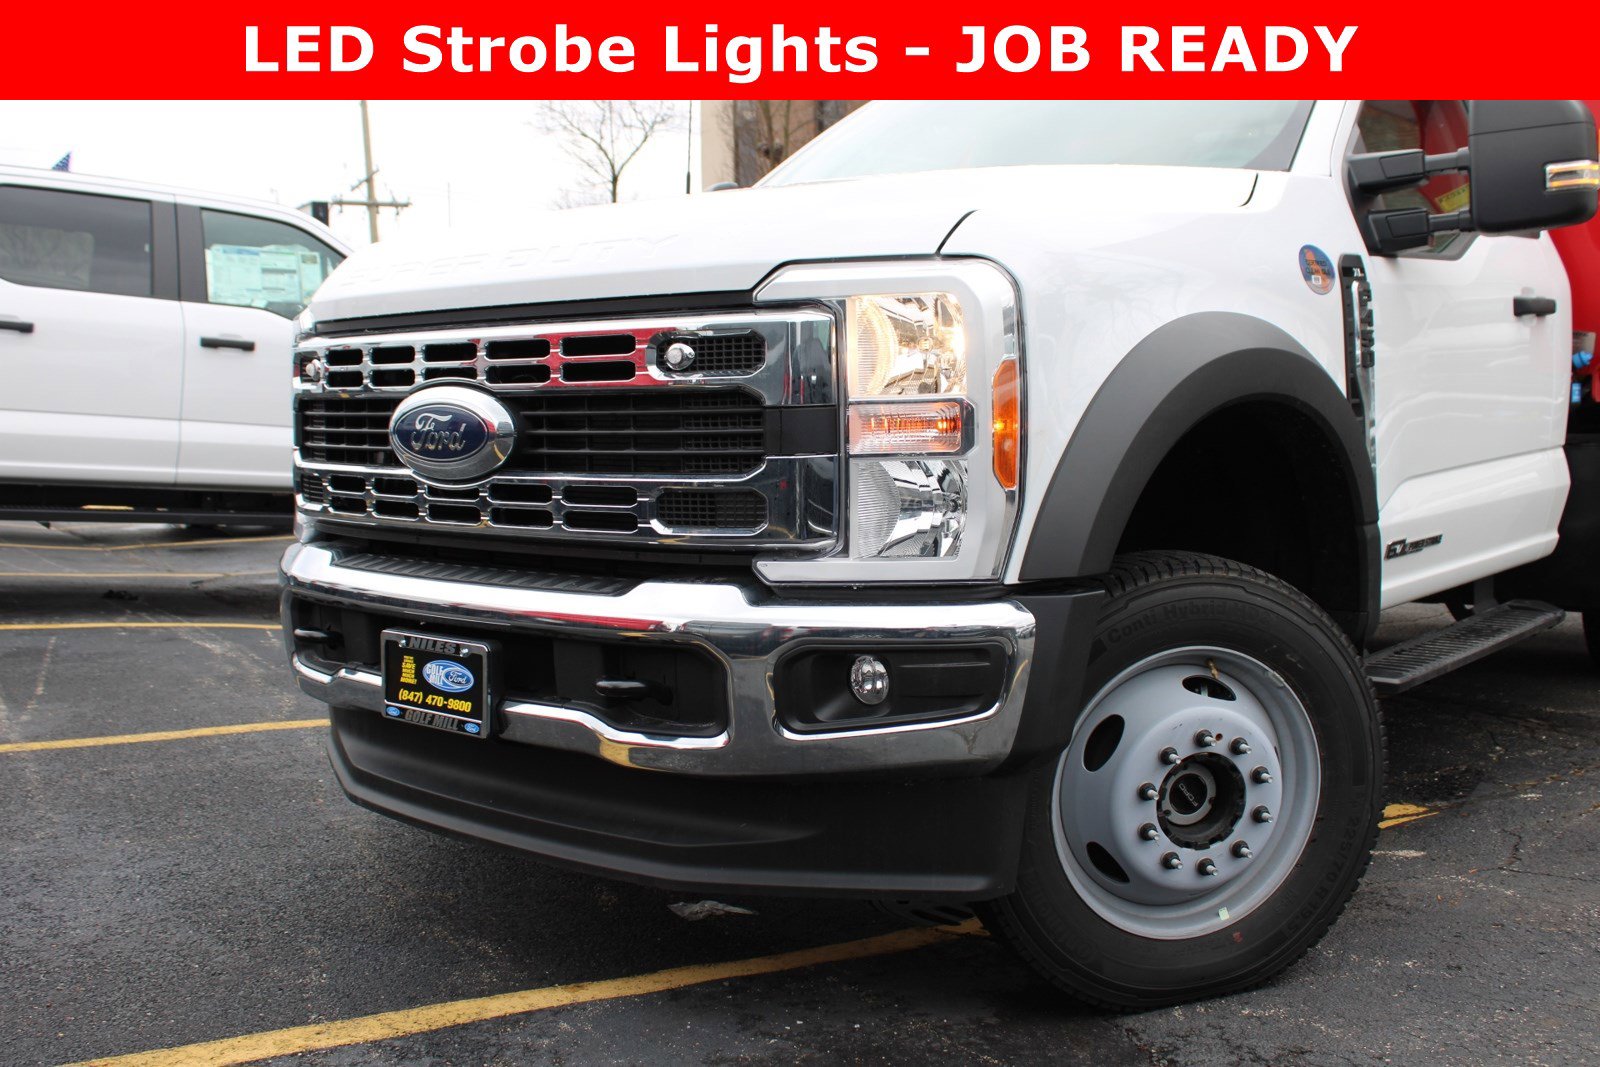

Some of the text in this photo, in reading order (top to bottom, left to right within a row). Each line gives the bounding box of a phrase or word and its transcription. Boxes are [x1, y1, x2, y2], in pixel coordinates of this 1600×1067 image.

[411, 412, 466, 451] Ford
[409, 637, 457, 654] NILES
[448, 671, 467, 684] Ford
[398, 688, 472, 713] (847) 470-9800
[404, 709, 459, 731] GOLF MILL
